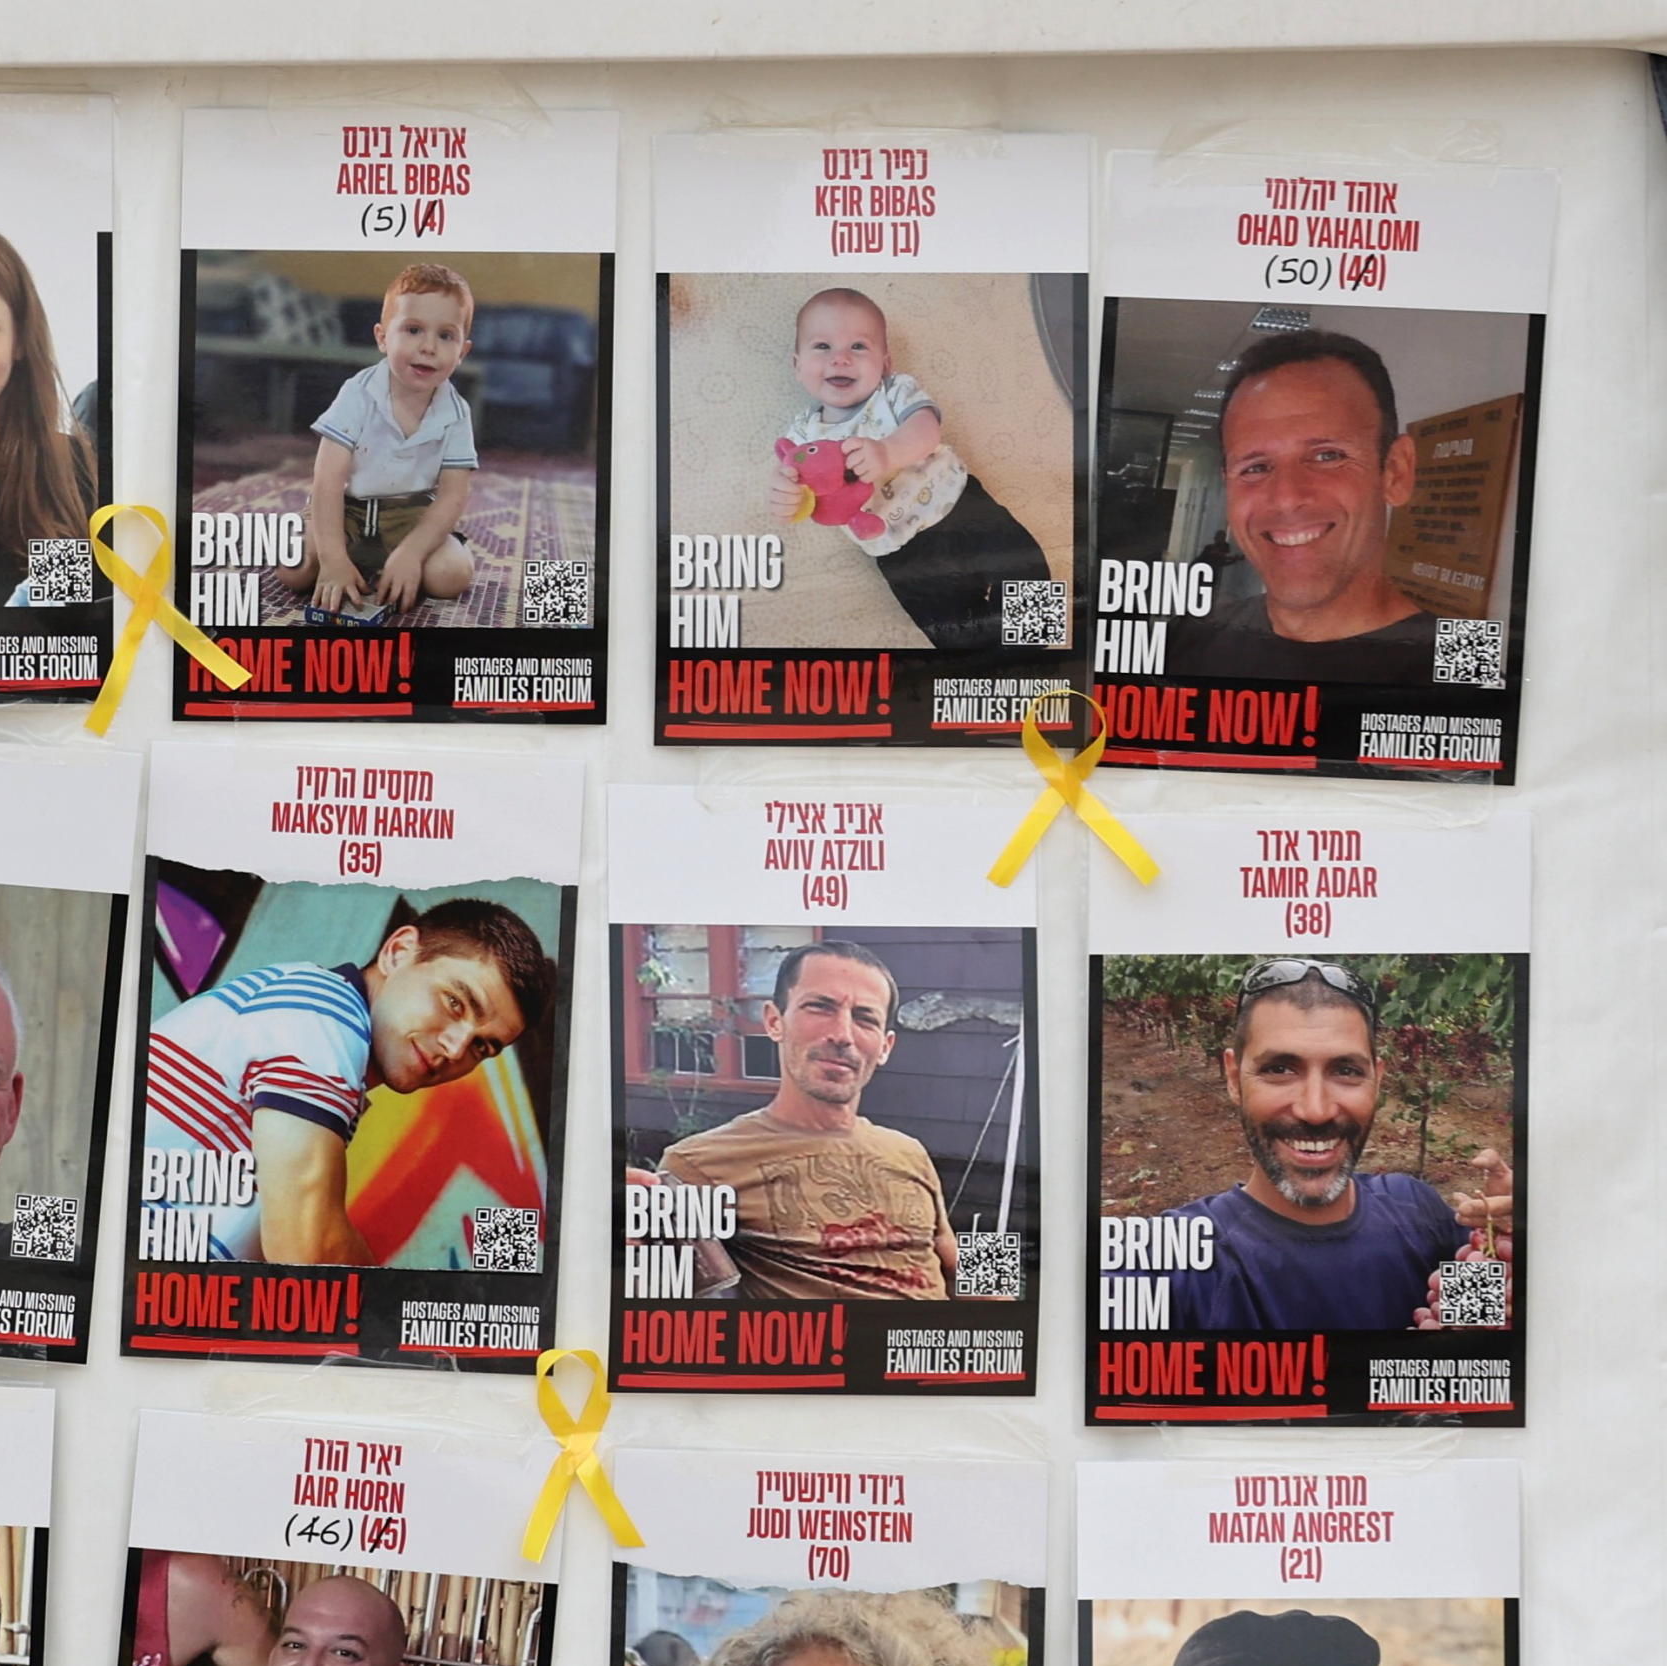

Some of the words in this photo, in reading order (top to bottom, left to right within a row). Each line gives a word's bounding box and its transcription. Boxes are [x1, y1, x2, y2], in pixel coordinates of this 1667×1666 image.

[336, 163, 399, 195] ARIEL
[404, 163, 472, 196] BIBAS
[1266, 177, 1337, 210] יהלומי
[815, 185, 863, 216] KFIR
[870, 185, 936, 216] BIBAS
[1342, 181, 1399, 214] אוהד
[1237, 214, 1300, 247] OHAD
[1306, 216, 1422, 251] YAHALOMI
[1265, 255, 1331, 290] (50)
[1098, 559, 1214, 617] BRING
[1094, 620, 1165, 675] HIM
[1092, 684, 1197, 742] HOME
[1207, 686, 1320, 748] NOW!
[271, 802, 369, 835] MAKSYM
[373, 807, 456, 840] HARKIN
[764, 840, 815, 870] AVIV
[821, 840, 885, 871] ATZILI
[1240, 866, 1310, 898] TAMIR
[1315, 866, 1378, 898] ADAR
[294, 1474, 341, 1507] IAIR
[344, 1479, 406, 1514] HORN
[747, 1508, 792, 1539] JUDI
[797, 1509, 914, 1542] WEINSTEIN
[1209, 1512, 1286, 1543] MATAN
[1291, 1511, 1395, 1543] ANGREST
